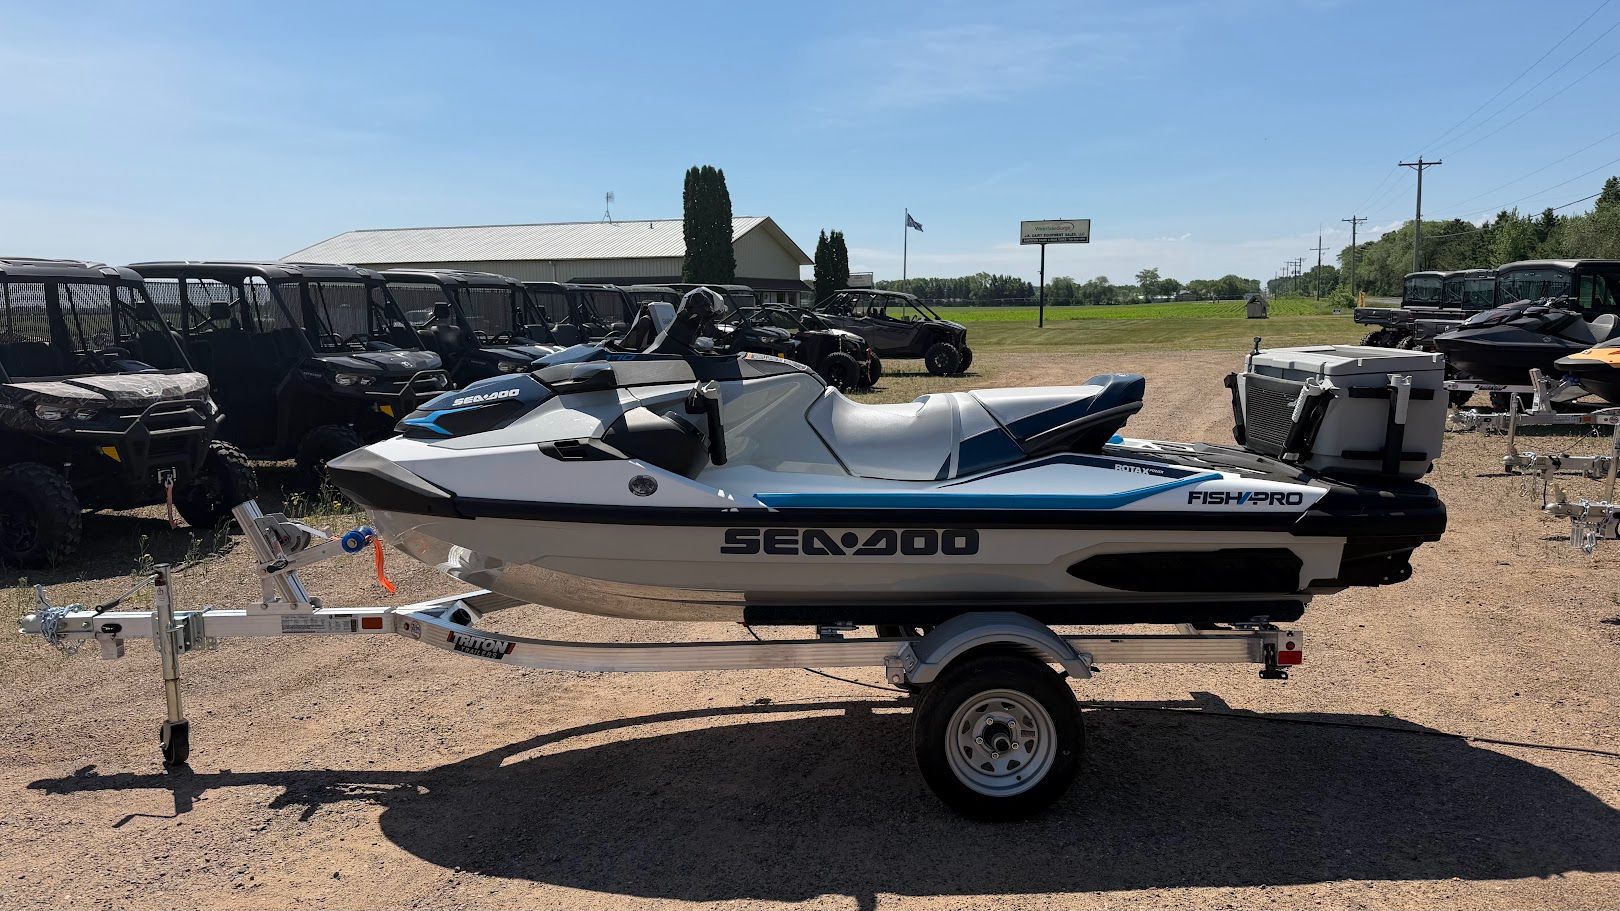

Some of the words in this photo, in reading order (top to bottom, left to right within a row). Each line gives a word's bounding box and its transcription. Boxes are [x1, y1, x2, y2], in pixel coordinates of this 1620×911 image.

[1115, 464, 1149, 474] ROTAX
[452, 632, 509, 654] TRITON
[460, 646, 498, 658] TRAILERS
